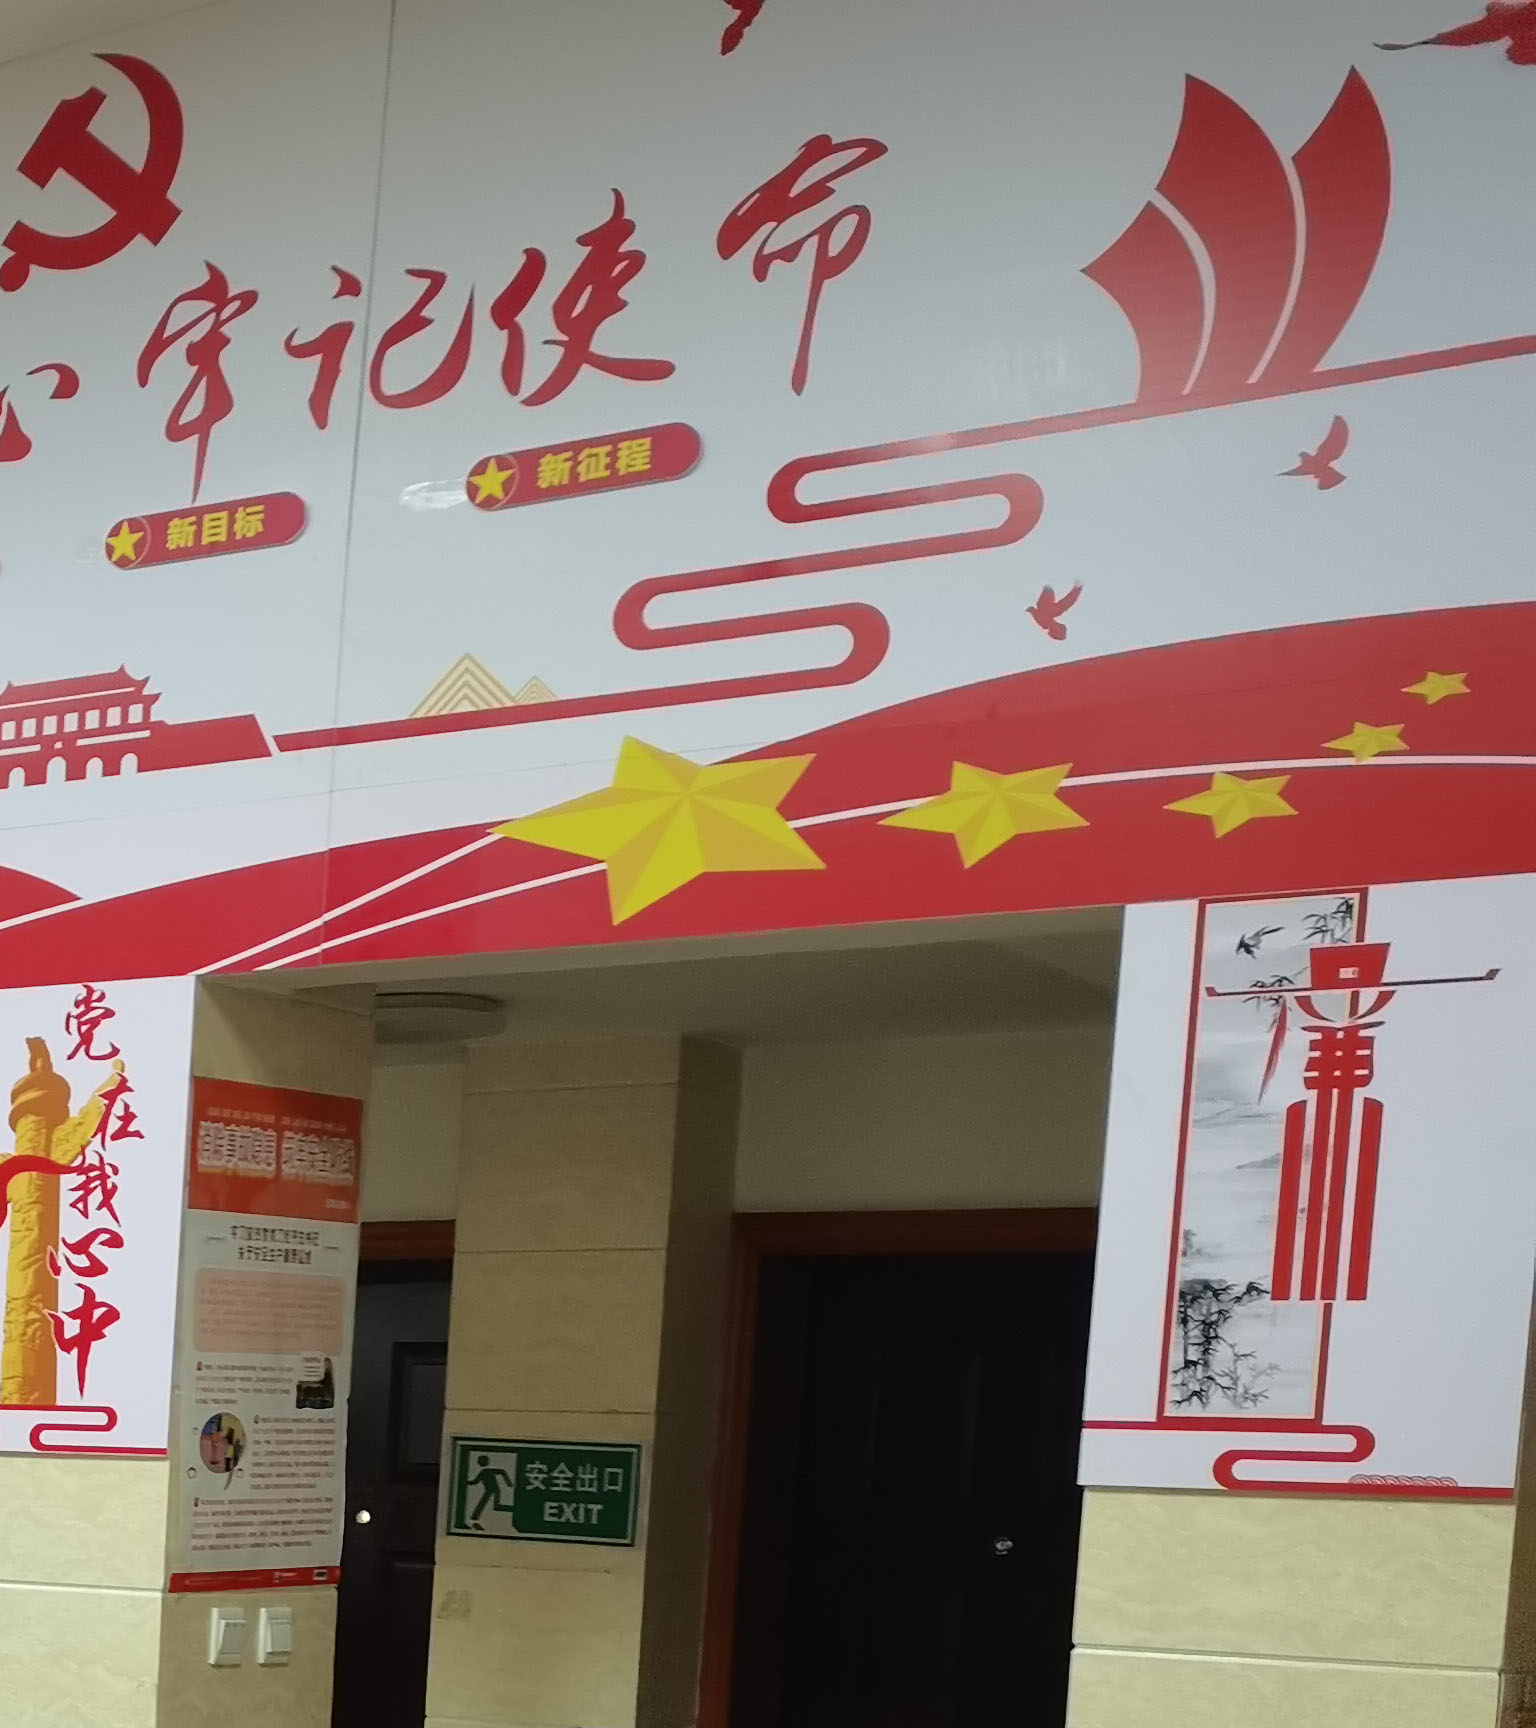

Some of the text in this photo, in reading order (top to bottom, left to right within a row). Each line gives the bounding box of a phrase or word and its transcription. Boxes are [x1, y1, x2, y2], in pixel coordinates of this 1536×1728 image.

[535, 436, 653, 491] 新征程
[164, 503, 266, 552] 新目标
[43, 983, 145, 1399] 党在我心中
[525, 1460, 624, 1494] 安全出口
[542, 1501, 604, 1525] EXIT
